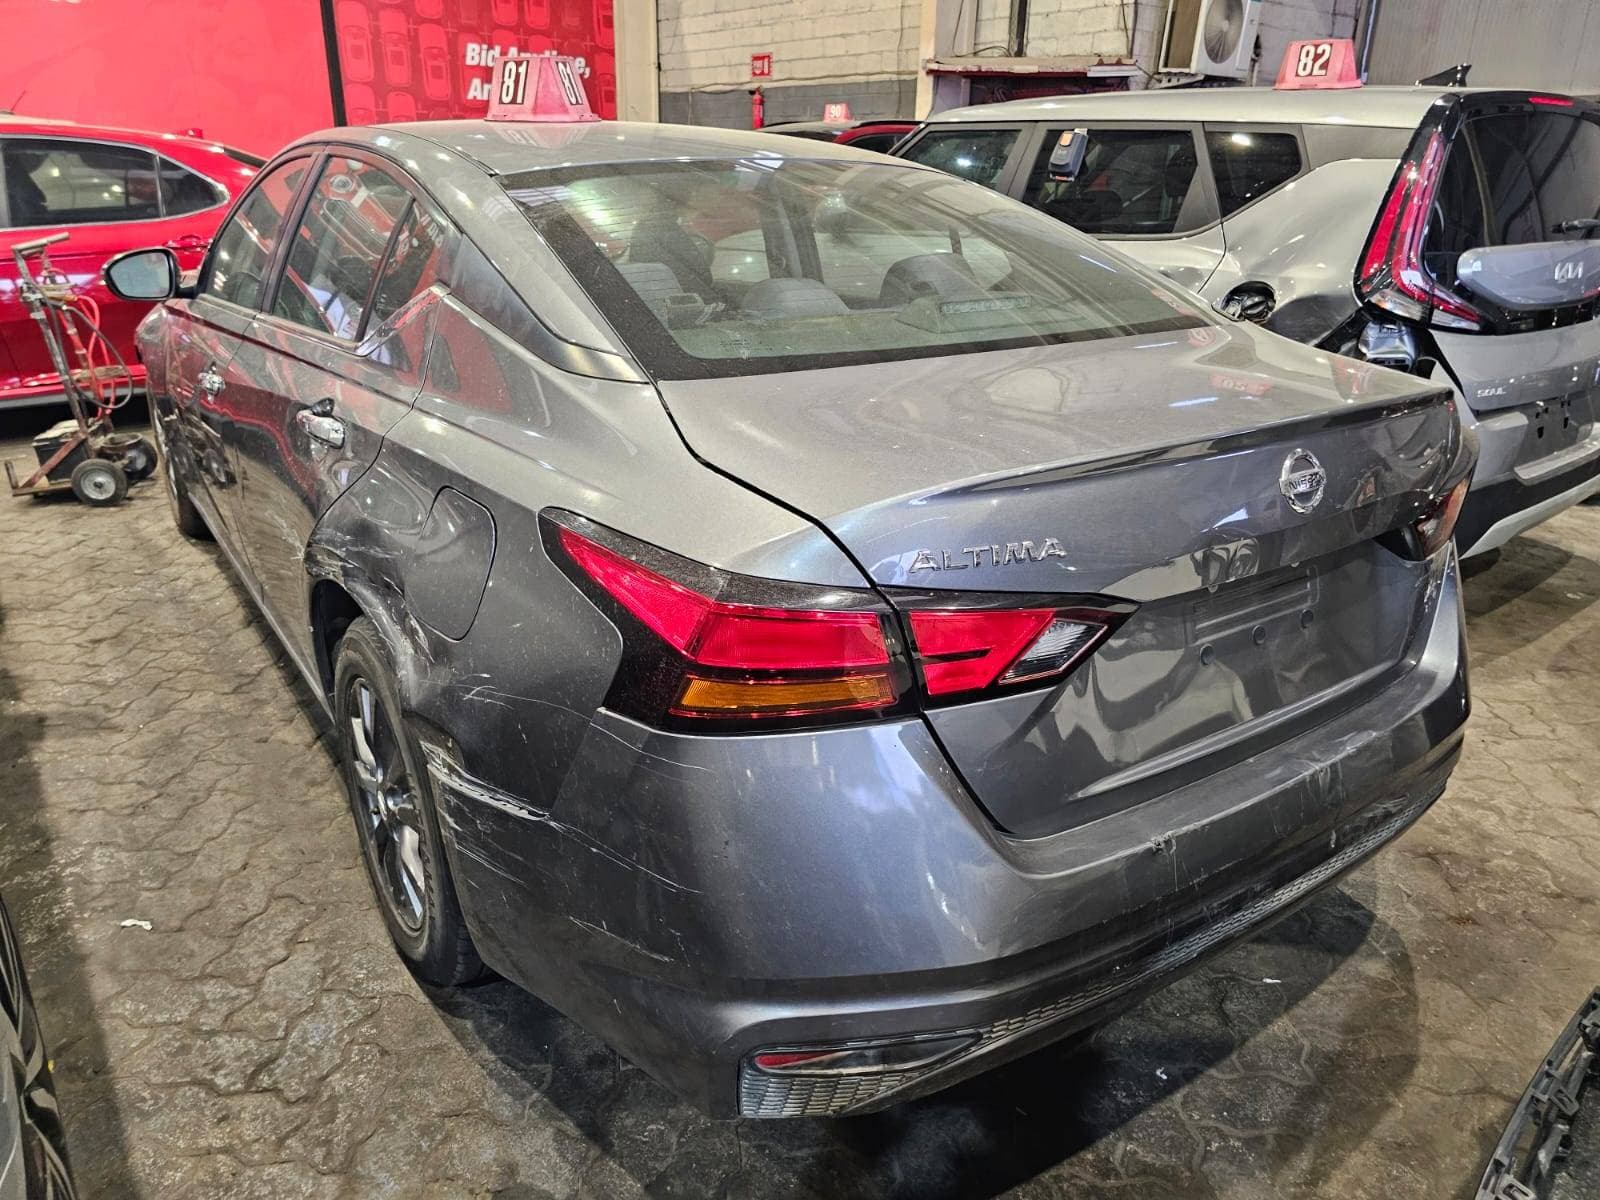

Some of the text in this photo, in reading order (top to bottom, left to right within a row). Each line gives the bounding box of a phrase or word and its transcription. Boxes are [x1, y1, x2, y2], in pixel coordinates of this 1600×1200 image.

[1297, 43, 1331, 77] 82
[501, 60, 528, 104] 81
[557, 62, 583, 105] 81
[909, 537, 1067, 573] ALTIMA
